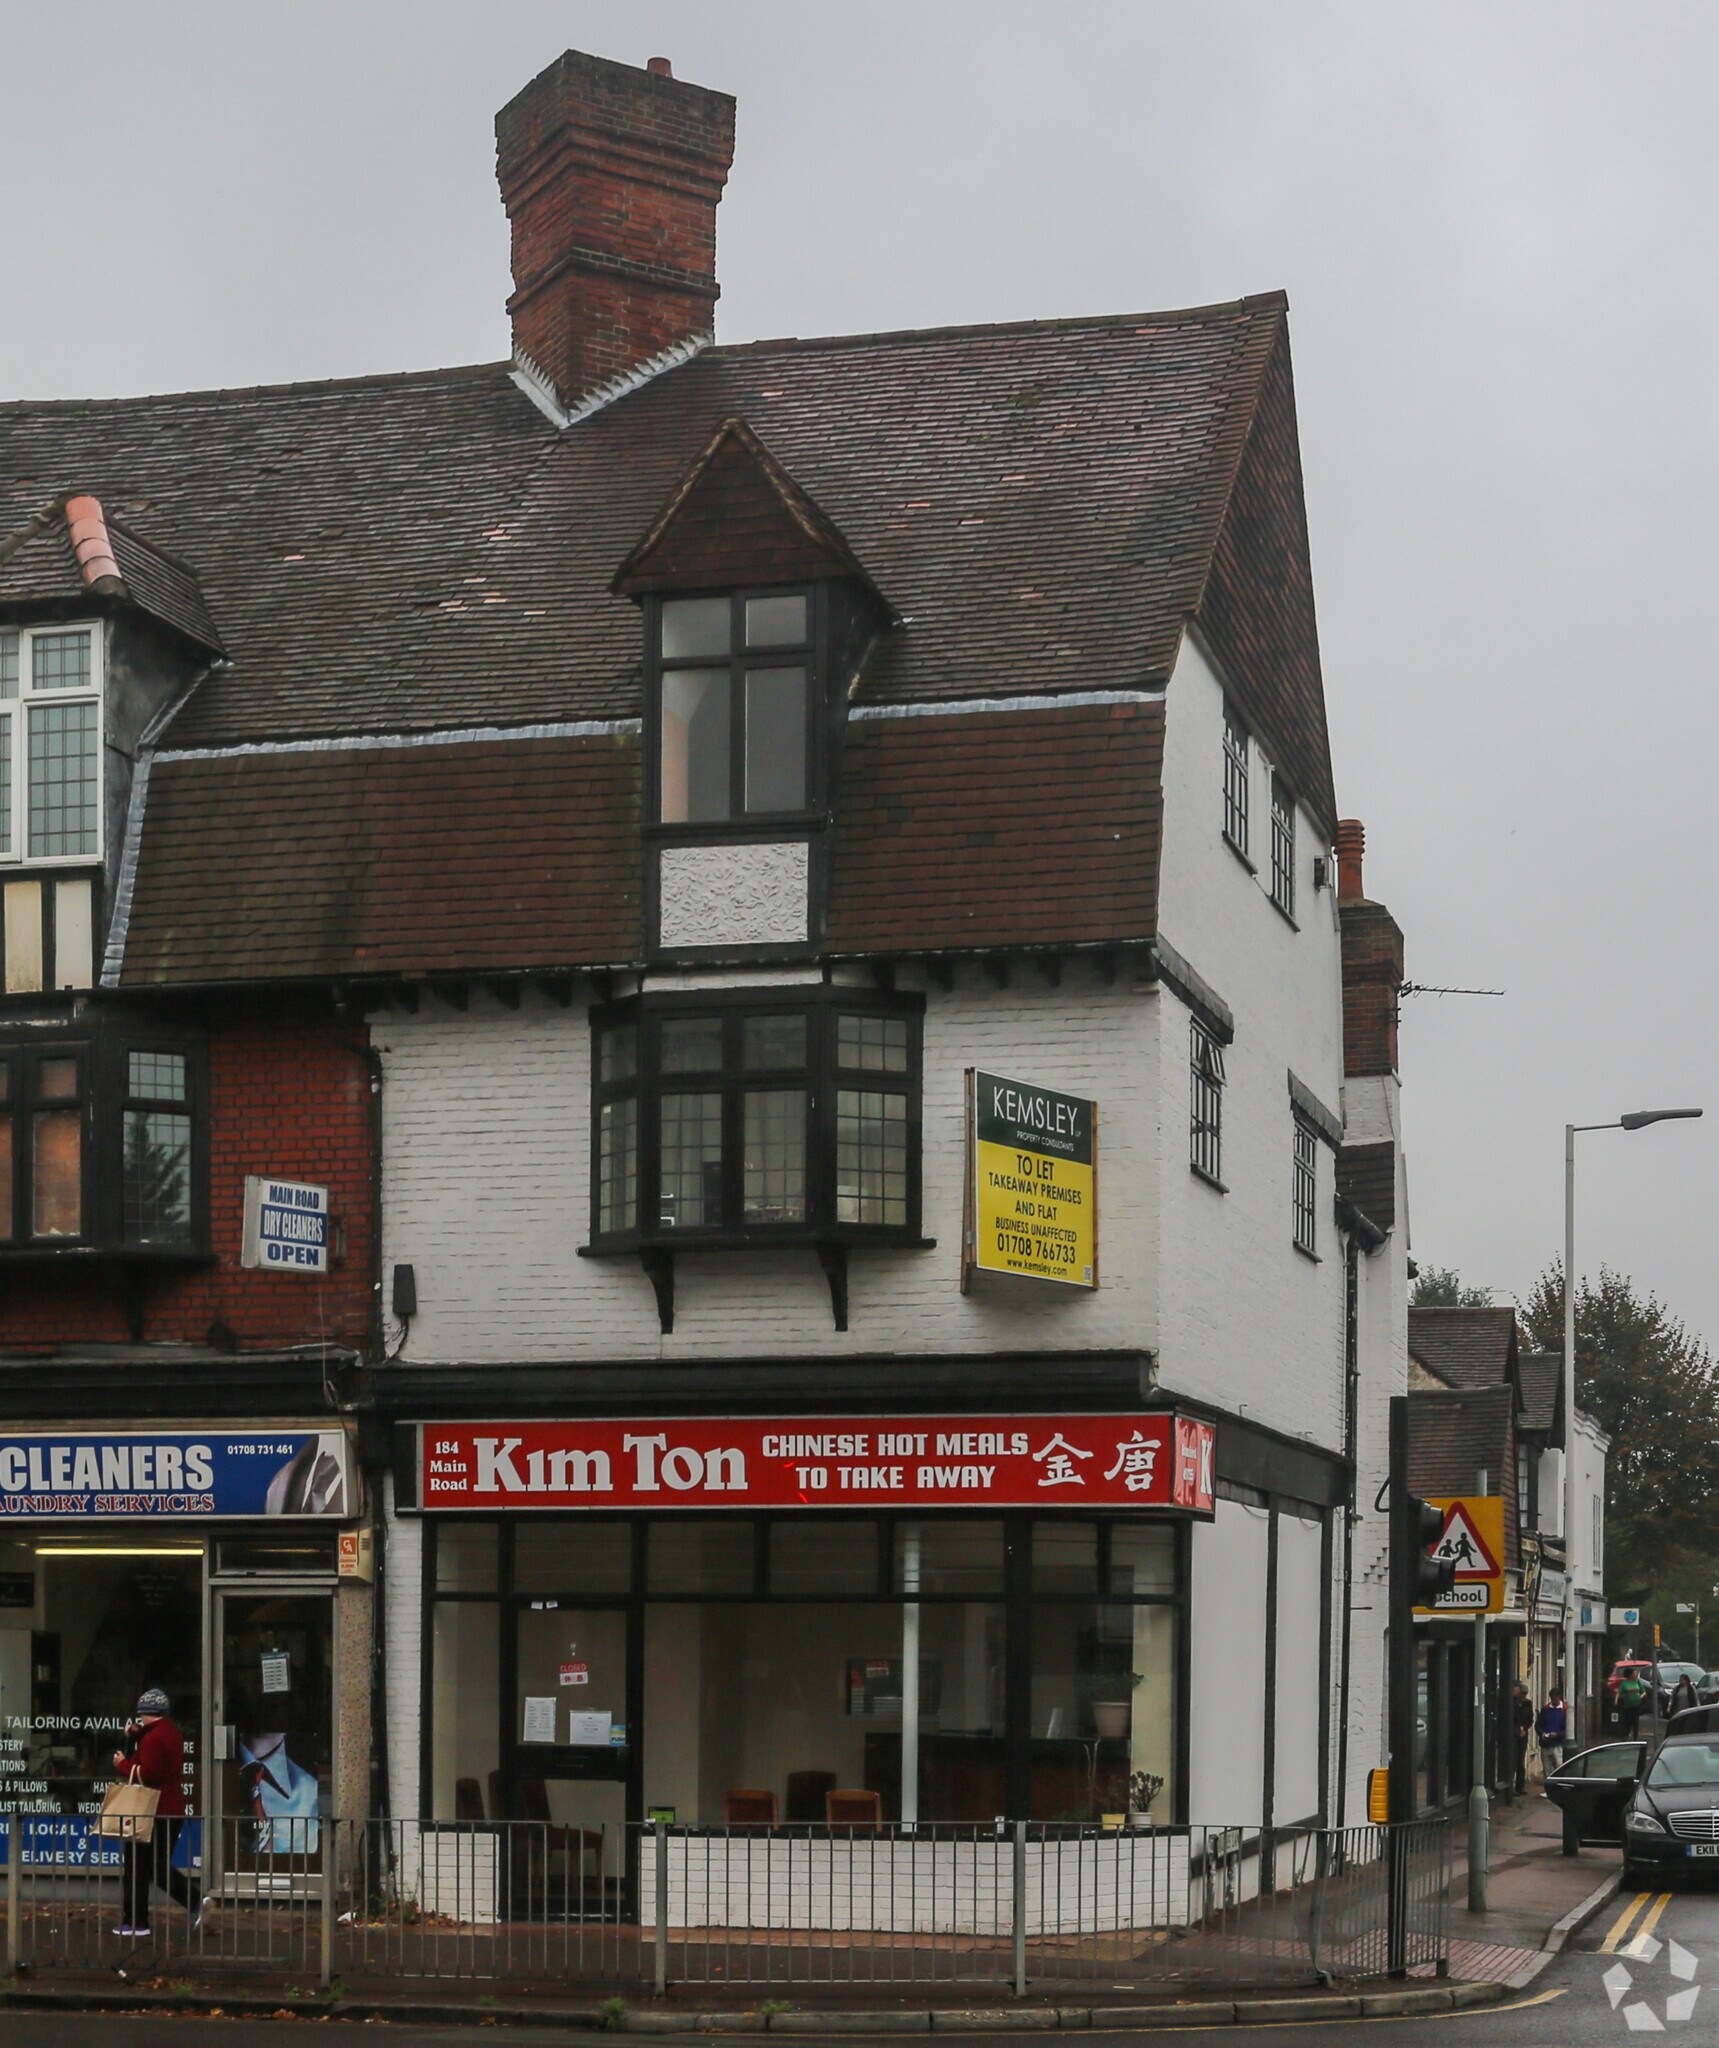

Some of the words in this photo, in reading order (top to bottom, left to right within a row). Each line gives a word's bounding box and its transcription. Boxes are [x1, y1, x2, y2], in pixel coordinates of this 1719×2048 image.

[994, 1086, 1078, 1136] KEMSLEY
[1016, 1130, 1040, 1142] PROPERTY
[1041, 1136, 1074, 1151] CONSULTANTS
[1016, 1154, 1032, 1176] TO
[1037, 1159, 1054, 1181] LET
[269, 1185, 293, 1206] MAIN
[295, 1189, 320, 1210] ROAD
[989, 1171, 1038, 1195] TAKEAWAY
[1041, 1183, 1082, 1205] PREMISES
[1015, 1200, 1035, 1216] AND
[1038, 1204, 1057, 1220] FLAT
[263, 1210, 281, 1237] DRY
[282, 1212, 323, 1243] CLEANERS
[995, 1216, 1029, 1234] BUSINESS
[1031, 1224, 1077, 1243] UNAFFECTED
[267, 1243, 319, 1266] OPEN
[997, 1233, 1032, 1257] 01708
[1036, 1240, 1076, 1264] 766733
[1007, 1259, 1067, 1275] www.kemsley.com
[227, 1445, 255, 1455] 01708
[257, 1445, 273, 1455] 731
[276, 1444, 293, 1455] 461
[435, 1441, 459, 1454] 184
[762, 1434, 869, 1457] CHINESE
[878, 1433, 928, 1456] HOT
[936, 1432, 1029, 1456] MEALS
[0, 1445, 214, 1492] CLEANERS
[430, 1459, 467, 1473] Main
[623, 1433, 748, 1491] Ton
[1032, 1430, 1162, 1492] 金唐
[430, 1478, 468, 1491] Road
[796, 1467, 828, 1489] TO
[837, 1466, 904, 1489] TAKE
[917, 1465, 996, 1489] AWAY
[94, 1493, 215, 1513] SERVICES
[5, 1715, 80, 1730] TAILORING
[5, 1781, 11, 1792] &
[13, 1781, 48, 1793] PILLOWS
[19, 1802, 61, 1814] TAILORING
[77, 1838, 87, 1850] &
